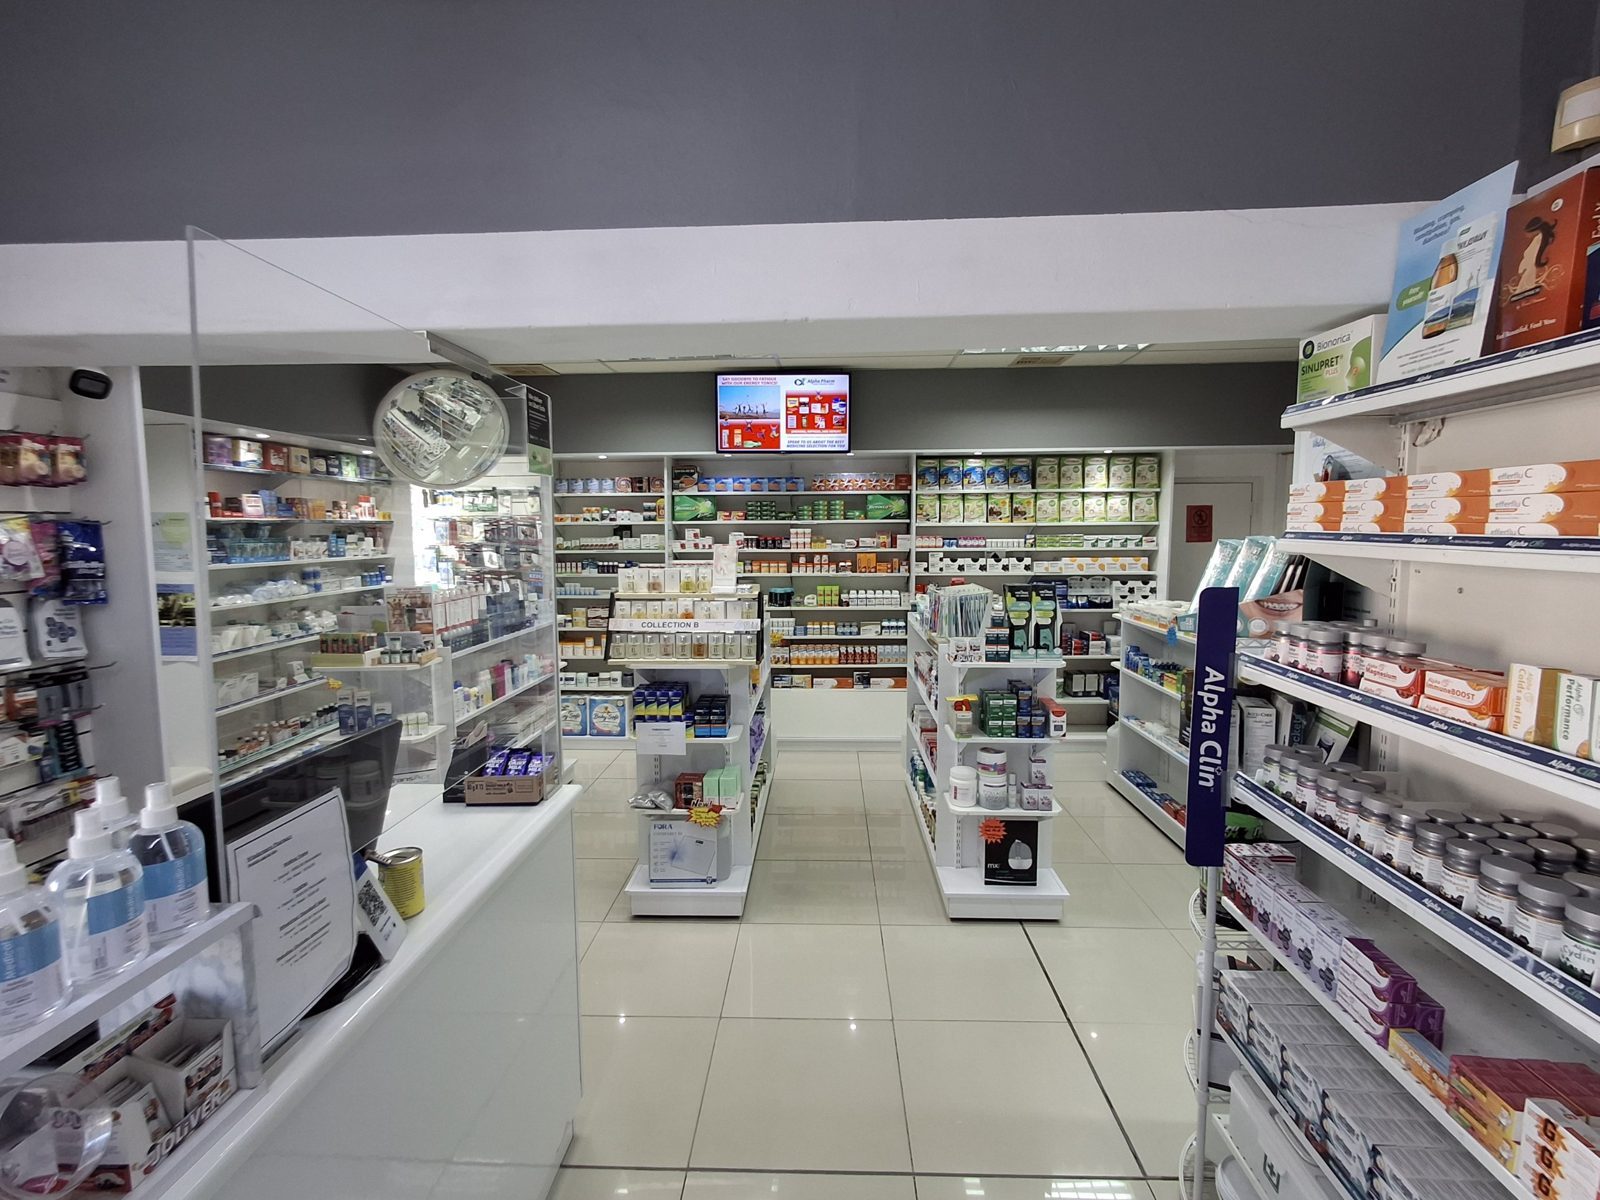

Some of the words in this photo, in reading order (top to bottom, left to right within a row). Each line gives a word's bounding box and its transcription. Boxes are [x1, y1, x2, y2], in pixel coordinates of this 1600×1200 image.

[1316, 333, 1351, 352] Bionorica
[1300, 356, 1340, 376] SINUPRET
[1506, 539, 1528, 548] Alpha
[1366, 666, 1397, 681] Magnesium
[1517, 668, 1526, 694] Colds
[1197, 666, 1225, 734] Alpha
[1562, 678, 1575, 740] Performance
[1428, 719, 1448, 730] Alpha
[1198, 740, 1224, 788] Clin
[1547, 760, 1576, 772] Alpha
[691, 799, 712, 807] New!
[1537, 970, 1565, 989] Alpha
